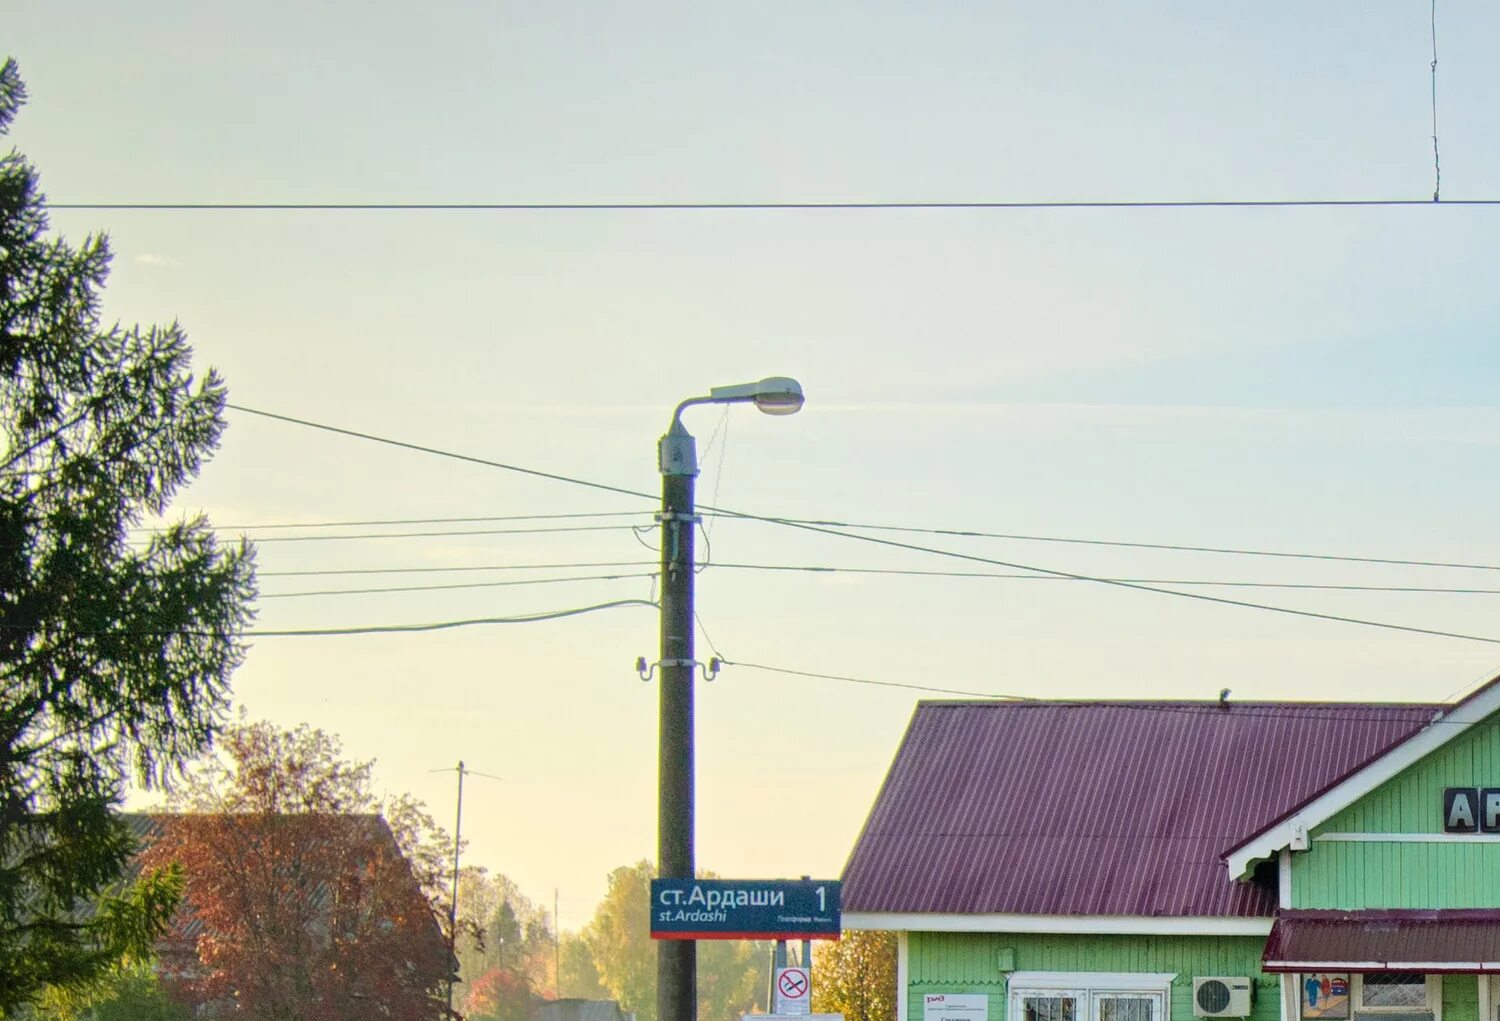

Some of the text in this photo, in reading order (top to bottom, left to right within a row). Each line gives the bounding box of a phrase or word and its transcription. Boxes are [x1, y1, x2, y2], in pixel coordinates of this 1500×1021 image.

[660, 885, 784, 911] ст.Ардаши
[815, 886, 826, 912] 1
[659, 909, 727, 922] st.Ardashi
